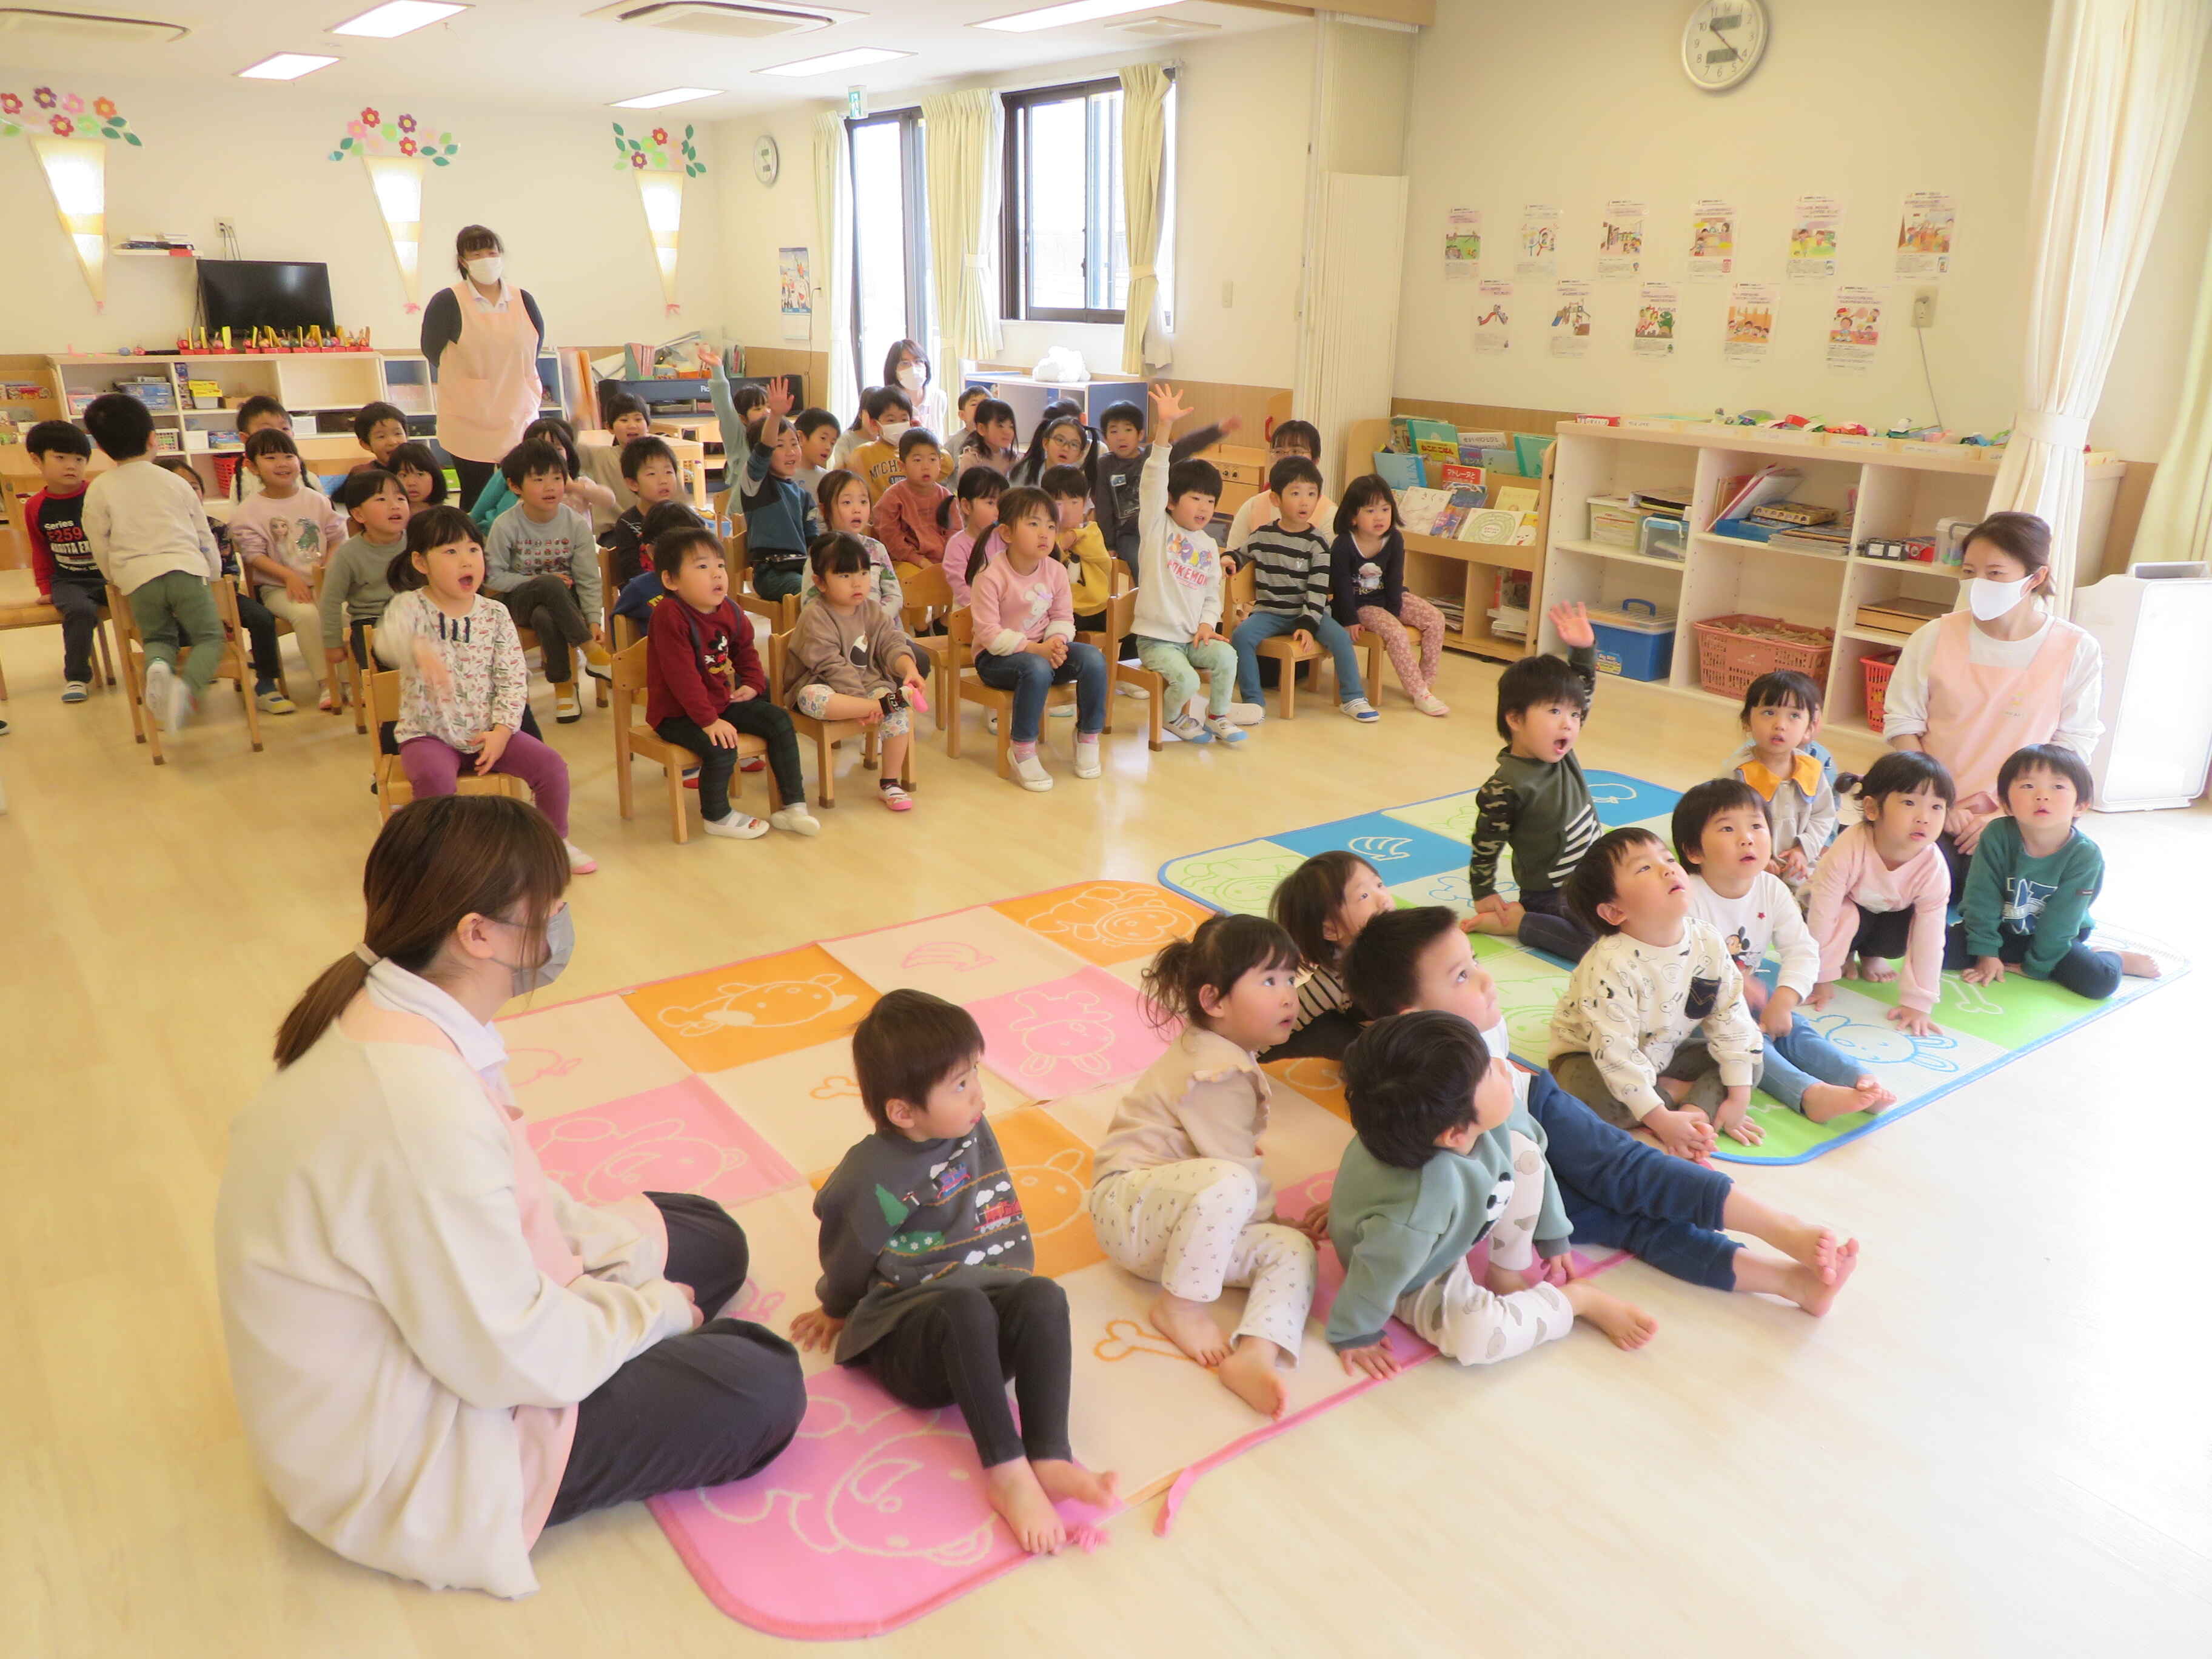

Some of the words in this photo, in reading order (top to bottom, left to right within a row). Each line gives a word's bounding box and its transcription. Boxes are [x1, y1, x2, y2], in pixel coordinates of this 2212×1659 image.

[1698, 22, 1708, 32] 10
[1693, 38, 1700, 49] 9
[1697, 53, 1703, 64] 8
[1717, 67, 1723, 78] 6
[869, 459, 898, 481] MICH
[44, 520, 75, 531] Series
